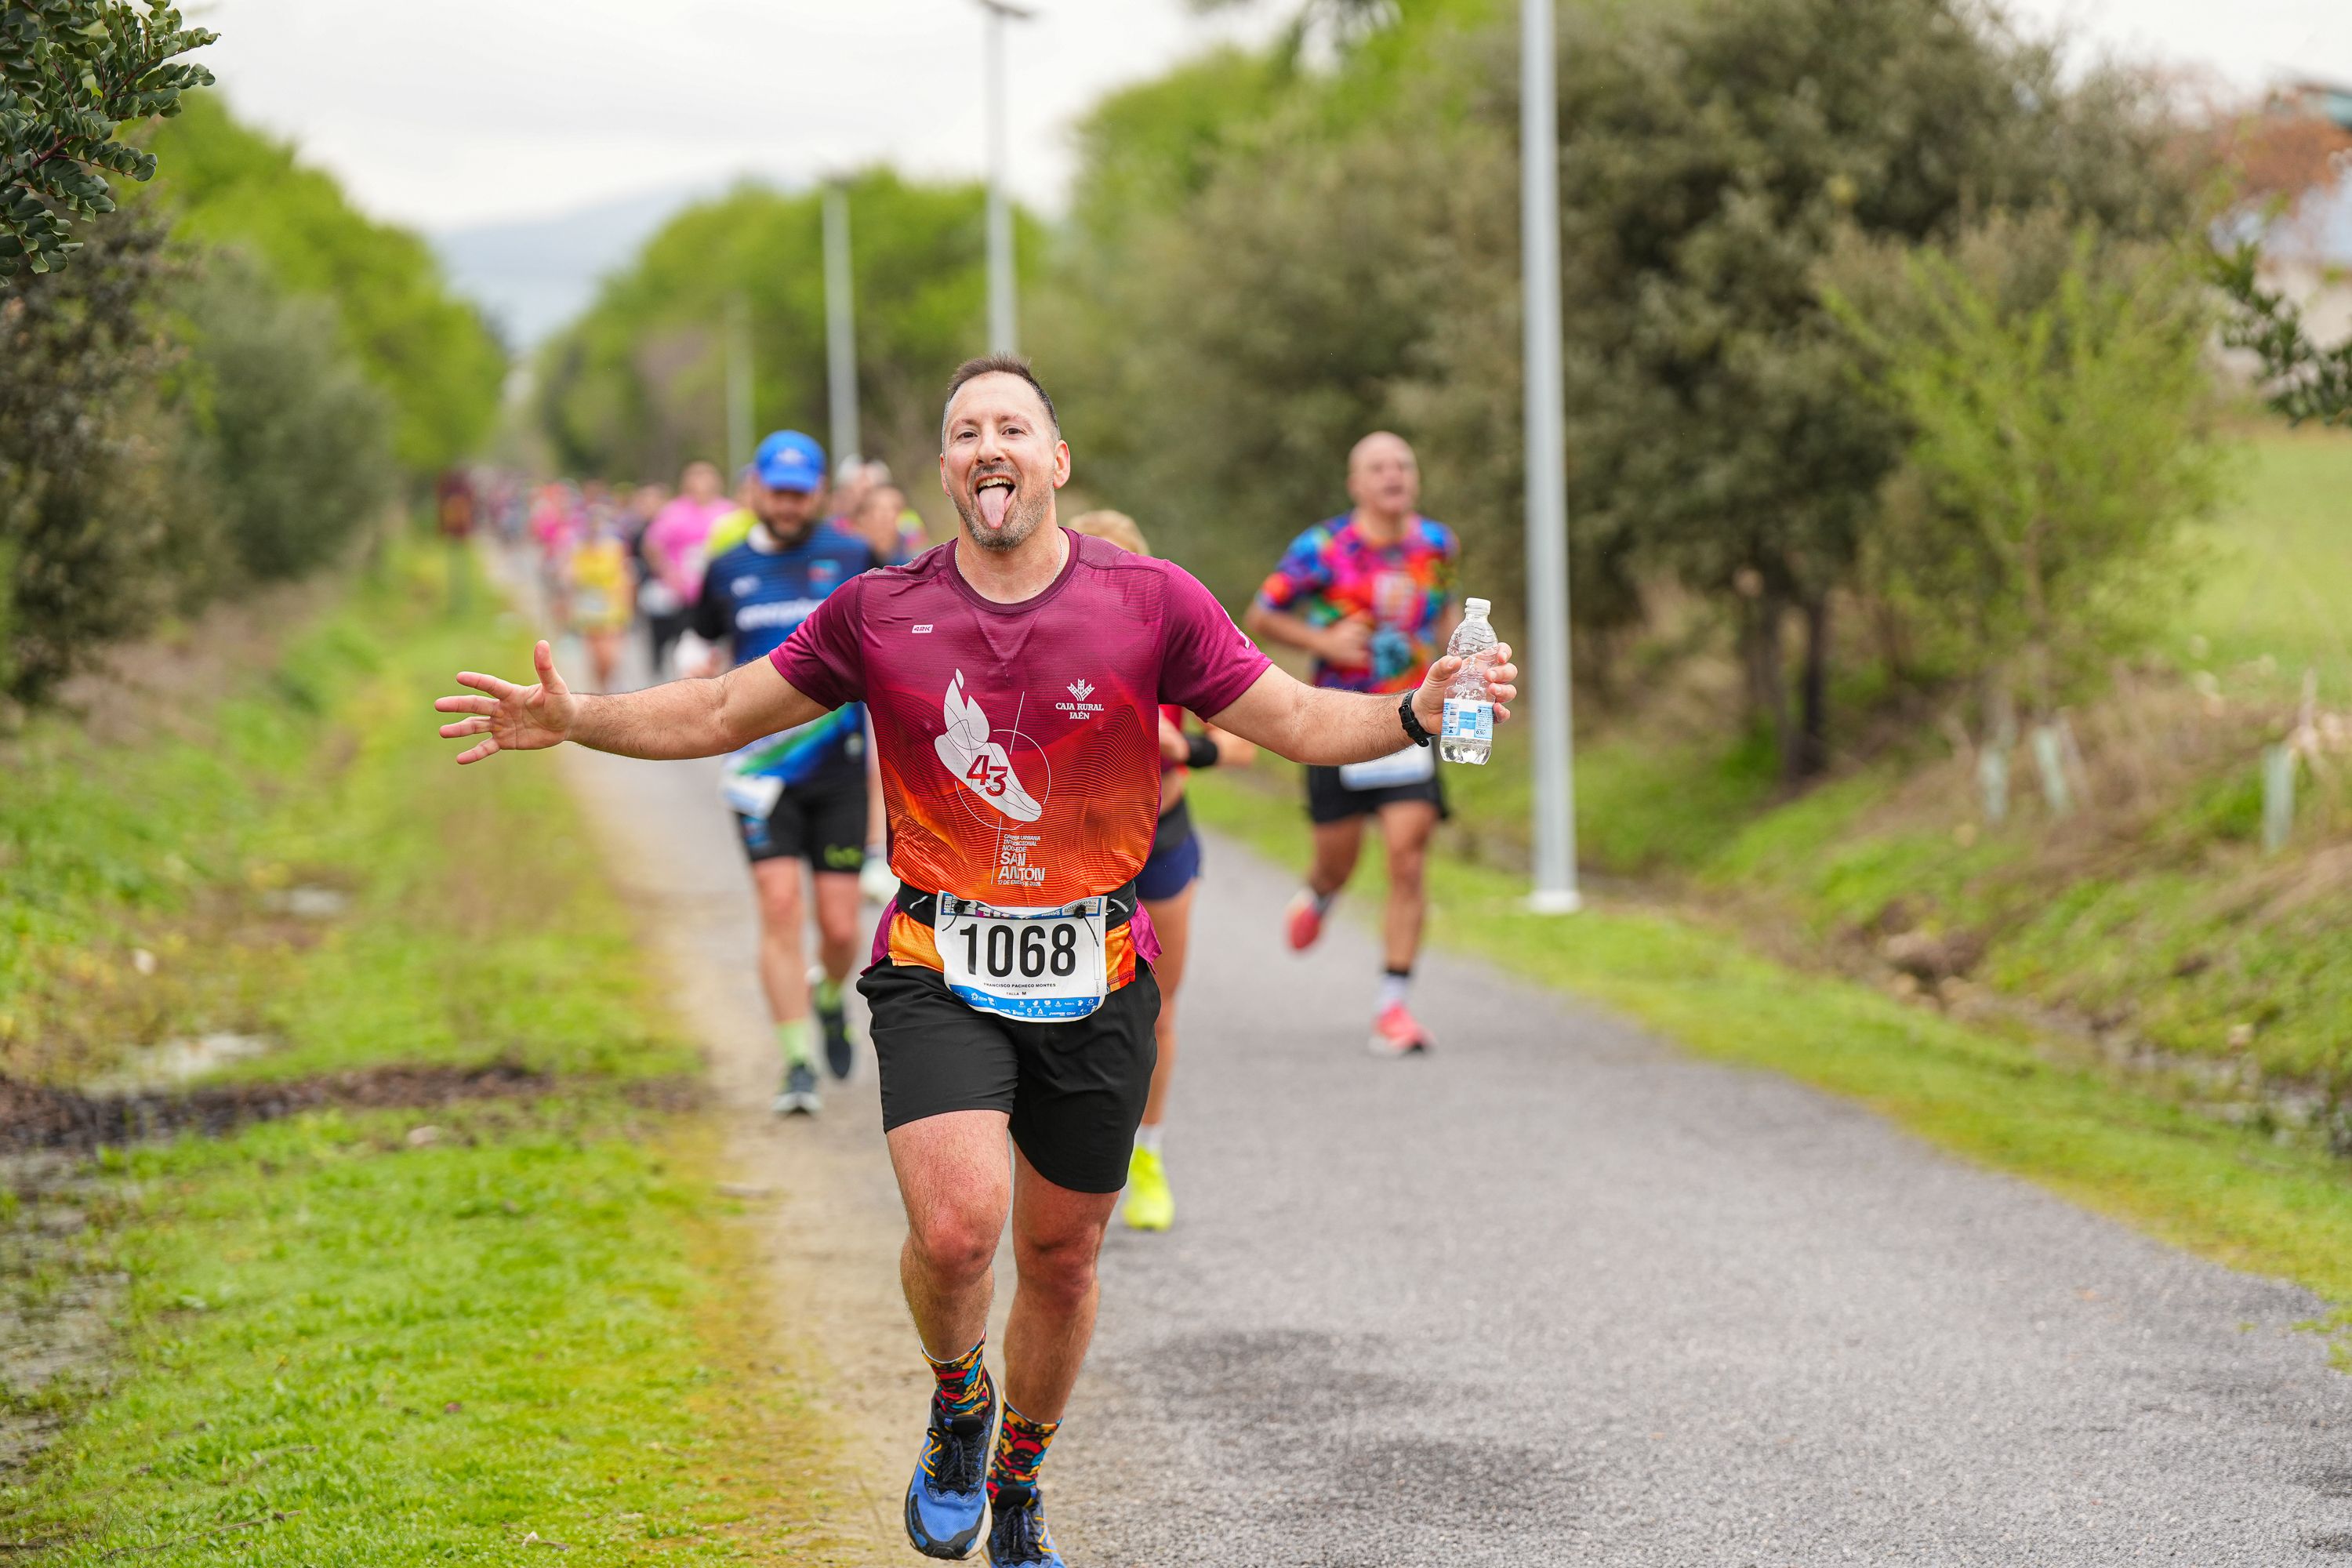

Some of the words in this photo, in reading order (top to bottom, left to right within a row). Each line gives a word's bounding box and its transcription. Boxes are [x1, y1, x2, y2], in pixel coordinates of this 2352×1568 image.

[1069, 711, 1090, 720] JAÉN
[966, 754, 1008, 797] 43
[1000, 851, 1026, 866] SAN
[998, 863, 1046, 881] ANTÓN
[960, 924, 1076, 978] 1068
